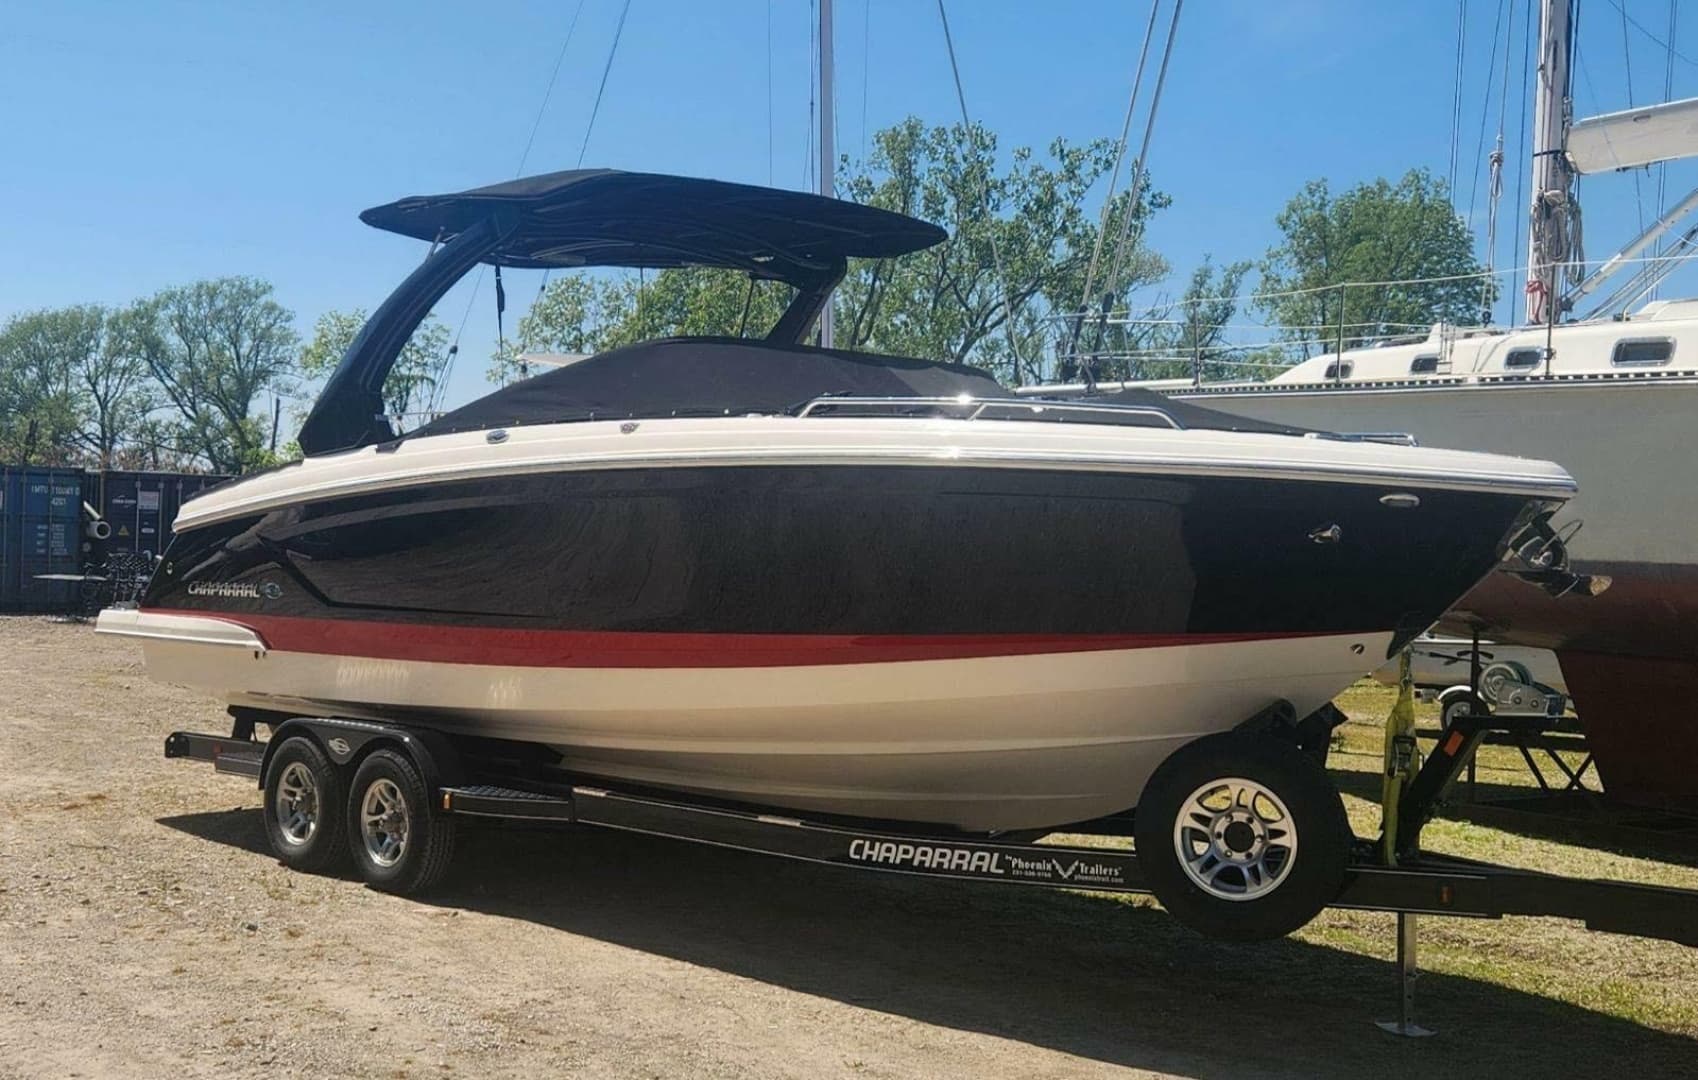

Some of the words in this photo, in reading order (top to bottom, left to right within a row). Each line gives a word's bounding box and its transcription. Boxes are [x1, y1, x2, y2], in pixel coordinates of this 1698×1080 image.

[187, 581, 261, 598] CHAPARRAL
[848, 839, 1004, 874] CHAPARRAL
[1011, 857, 1052, 871] Phoenix
